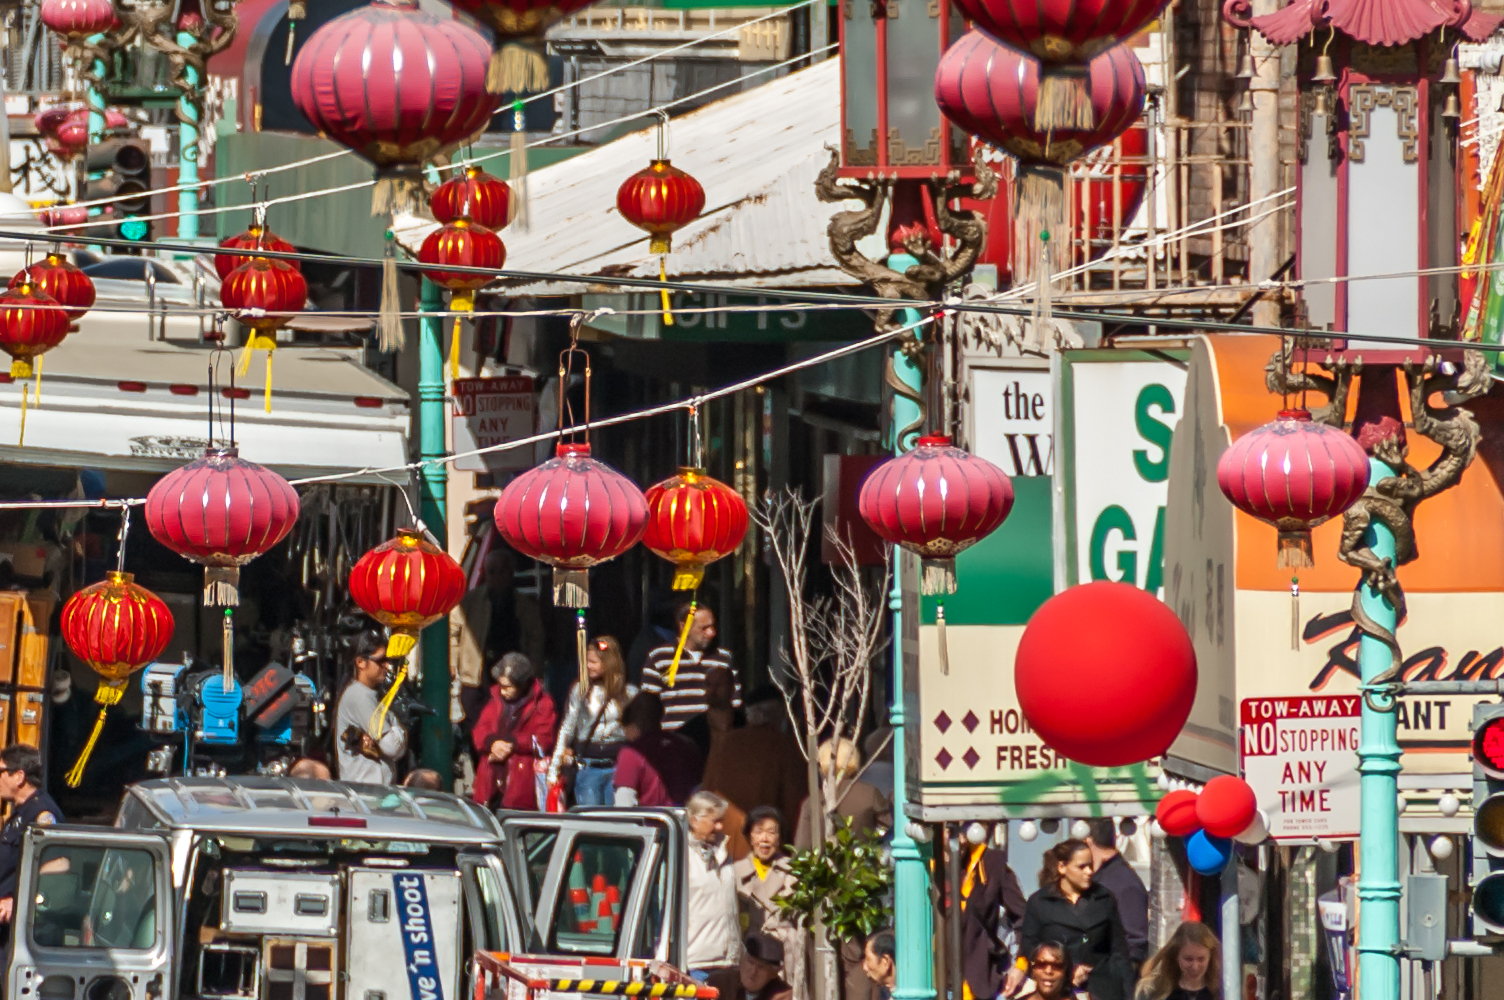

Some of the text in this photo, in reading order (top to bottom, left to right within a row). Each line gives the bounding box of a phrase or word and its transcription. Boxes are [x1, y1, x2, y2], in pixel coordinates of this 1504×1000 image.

[478, 396, 531, 412] STOPPING
[1003, 381, 1045, 422] the
[479, 418, 509, 433] ANY
[1005, 433, 1054, 476] W
[990, 709, 1036, 735] HOM
[1248, 698, 1357, 720] TOW-AWAY
[1397, 701, 1451, 731] ANT
[1245, 722, 1359, 755] NO STOPPING
[997, 745, 1067, 771] FRESH
[1281, 760, 1328, 785] ANY
[1278, 789, 1332, 813] TIME
[399, 876, 429, 944] shoot
